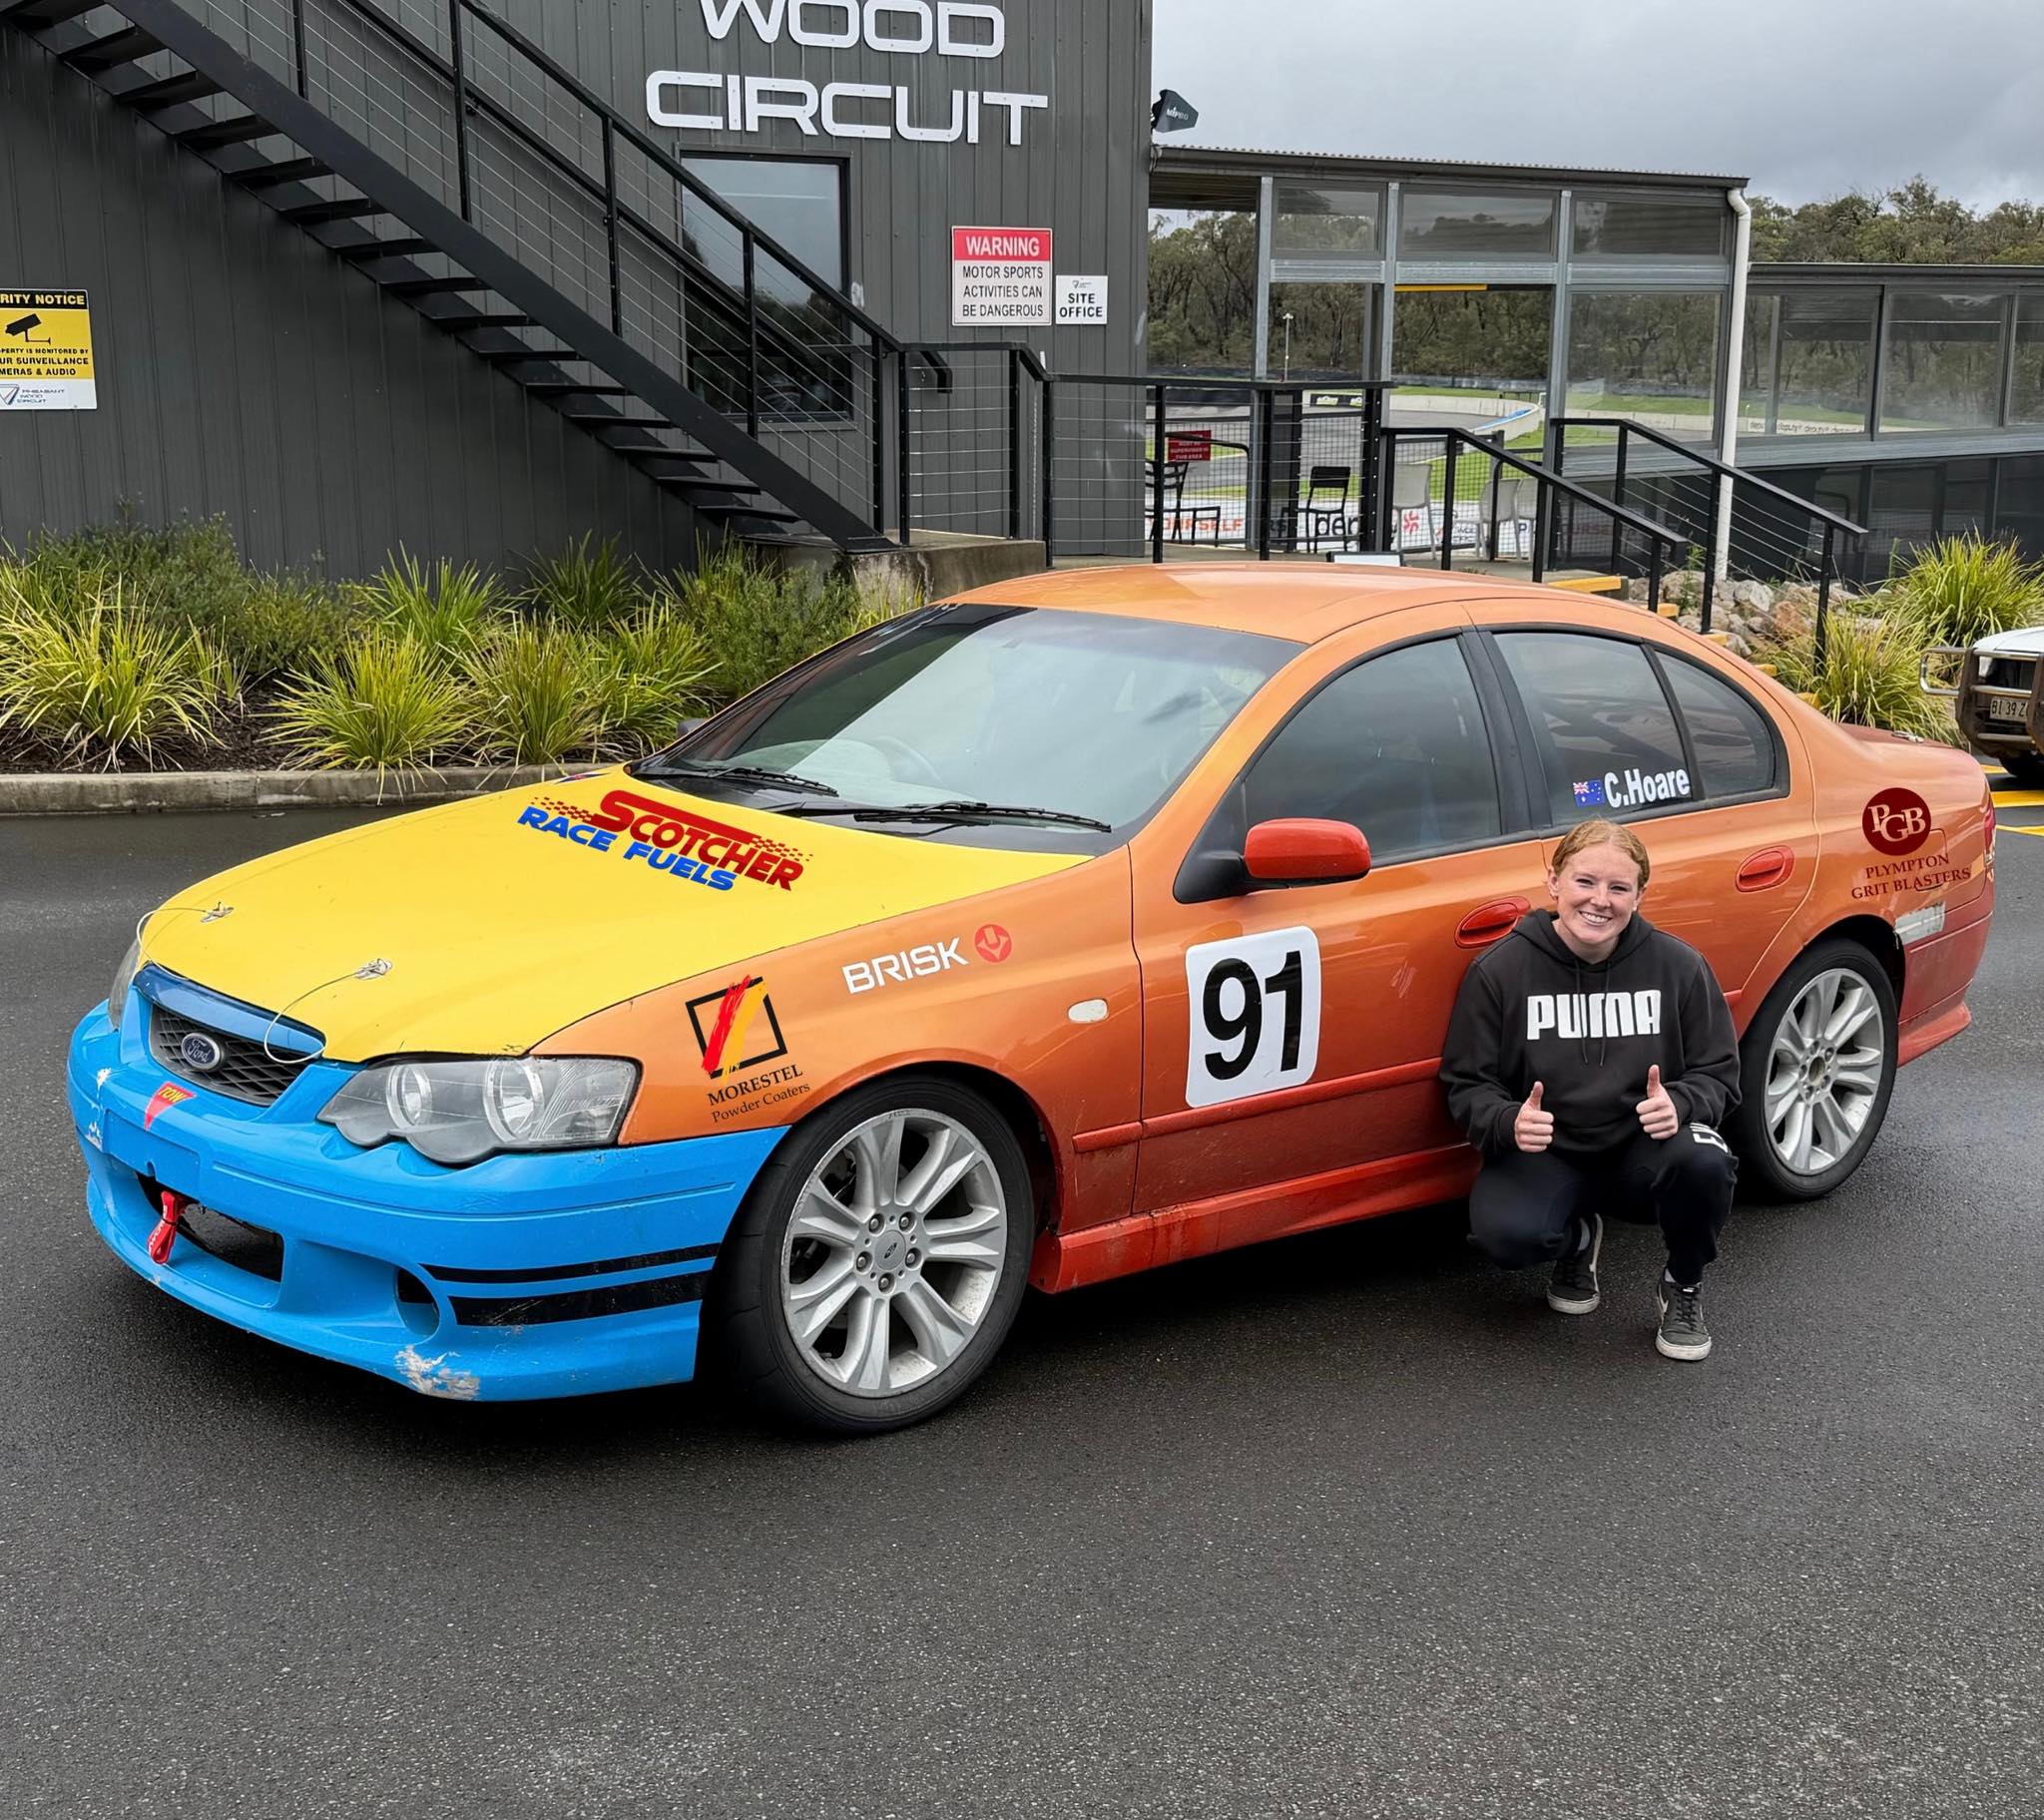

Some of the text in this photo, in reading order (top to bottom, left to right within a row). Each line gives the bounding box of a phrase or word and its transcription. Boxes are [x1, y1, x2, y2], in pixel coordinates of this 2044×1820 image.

[701, 0, 1005, 58] WOOD
[646, 70, 1048, 146] CIRCUIT
[966, 235, 1040, 256] WARNING
[962, 265, 1044, 279] MOTOR SPORTS
[35, 294, 86, 305] NOTICE
[963, 284, 1043, 298] ACTIVITIES CAN
[1068, 292, 1095, 304] SITE
[962, 304, 1044, 317] BE DANGEROUS
[1059, 306, 1103, 318] OFFICE
[2006, 700, 2017, 715] 39
[1604, 768, 1691, 808] C.Hoare
[1867, 803, 1926, 842] PGB
[517, 806, 738, 891] RACE FUELS
[1865, 853, 1949, 879] PLYMPTON
[1851, 867, 1971, 899] GRIT BLASTERS
[841, 936, 970, 995] BRISK
[1202, 950, 1302, 1081] 91
[1527, 989, 1661, 1040] PUMA
[187, 1038, 212, 1063] Ford
[157, 1086, 189, 1103] TOW
[707, 1064, 803, 1107] MORESTEL
[712, 1083, 810, 1123] Powder Coaters
